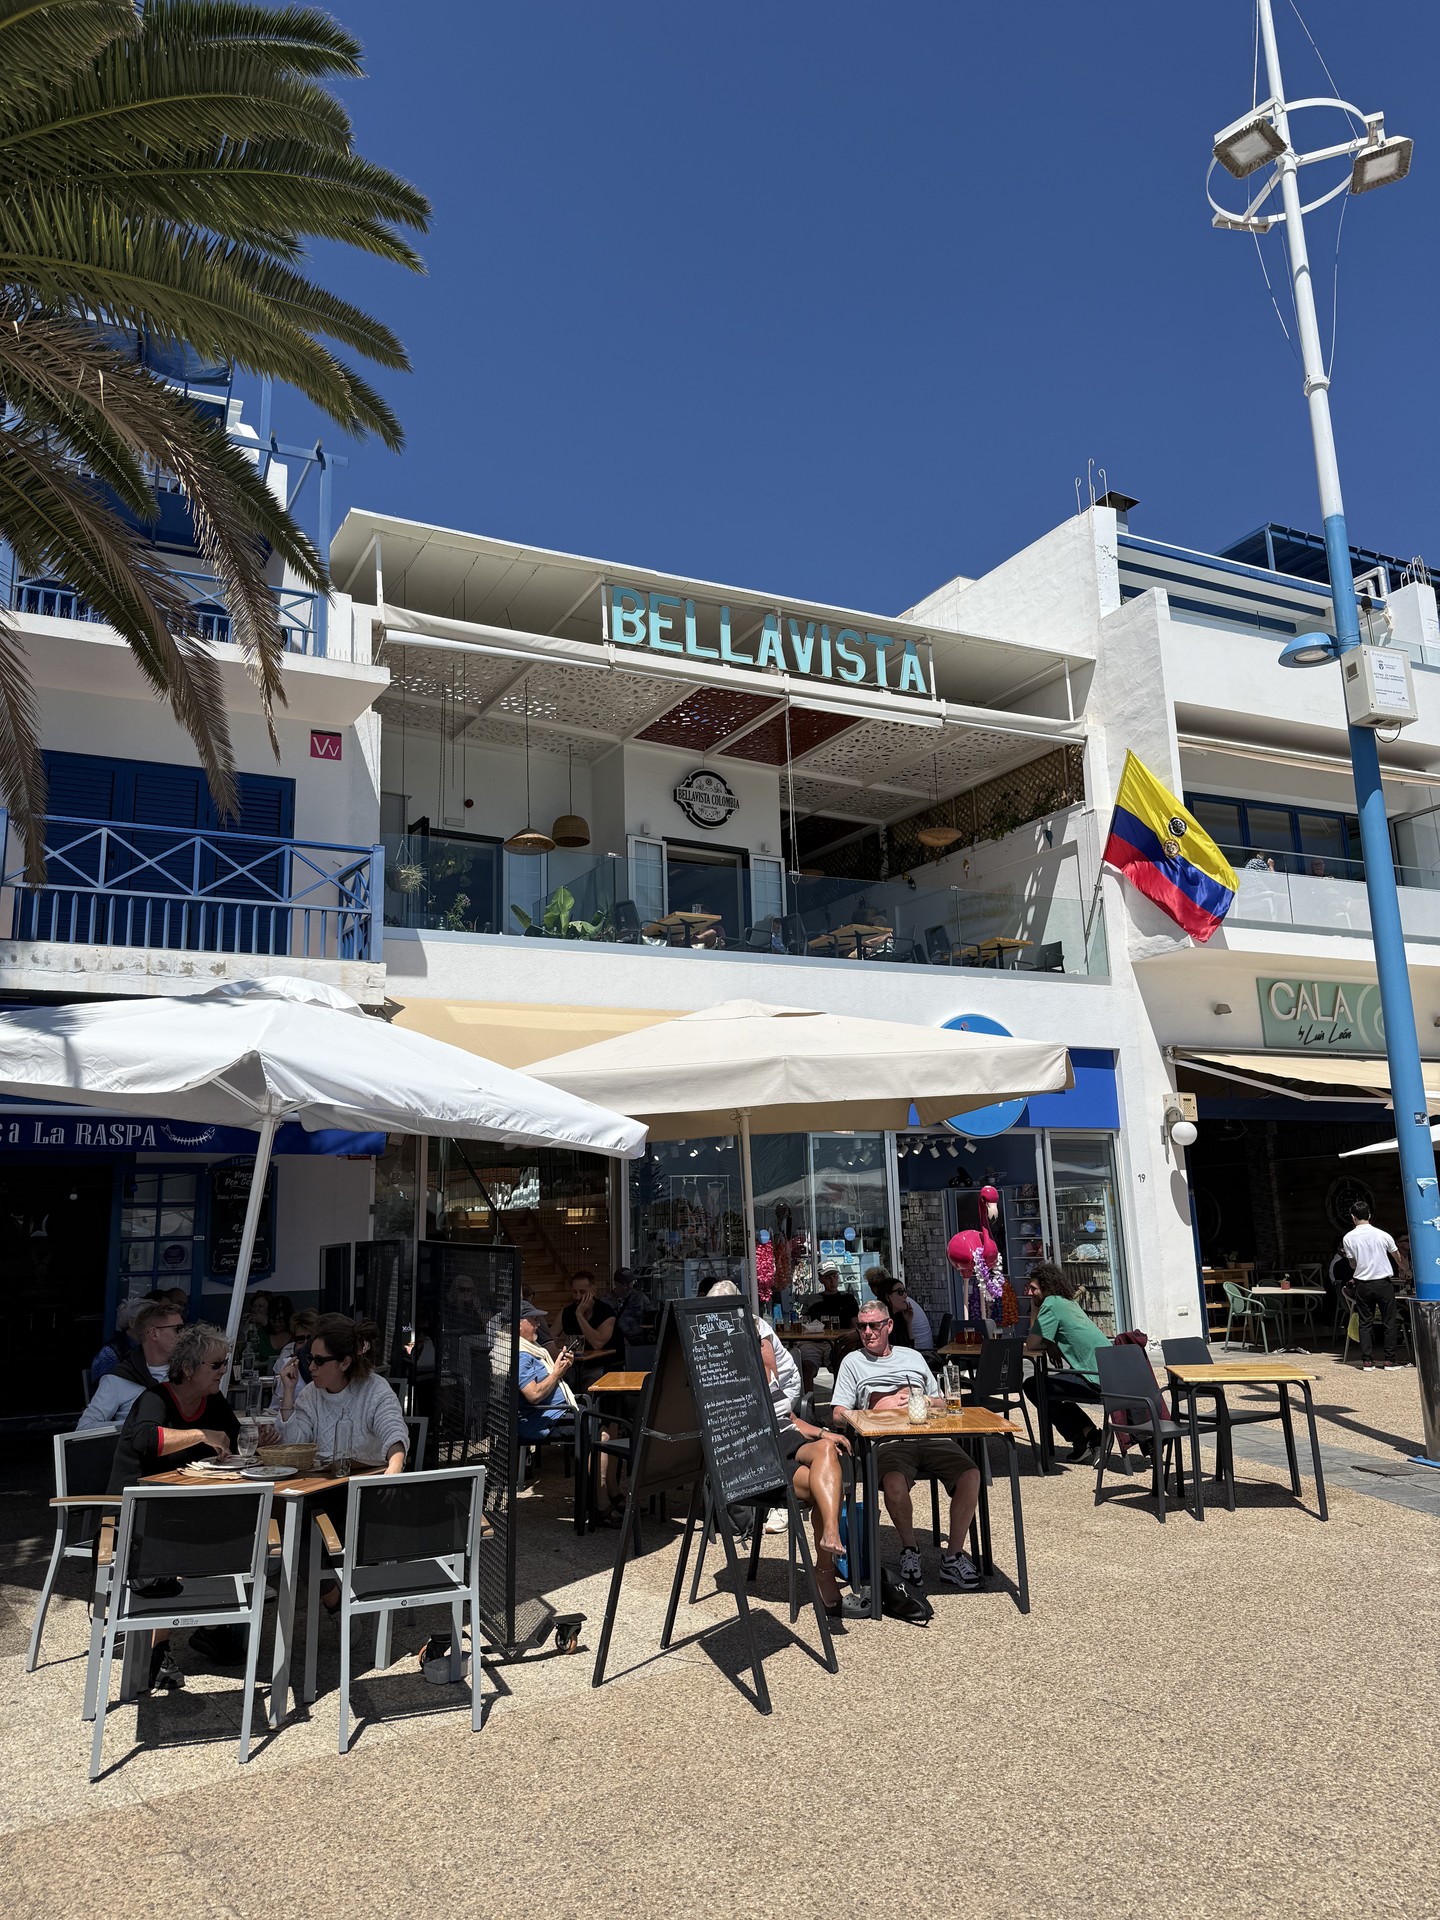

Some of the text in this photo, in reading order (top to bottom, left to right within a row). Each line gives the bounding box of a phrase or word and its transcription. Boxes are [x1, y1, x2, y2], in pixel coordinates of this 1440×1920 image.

[612, 585, 927, 693] BELLAVISTA
[677, 788, 740, 809] BELLAVISTA COLOMBIA
[1269, 981, 1354, 1023] CALA
[1303, 1024, 1325, 1045] Luis
[1328, 1023, 1352, 1044] León
[33, 1122, 65, 1145] La
[74, 1123, 157, 1147] RASPA
[1137, 1173, 1146, 1183] 19
